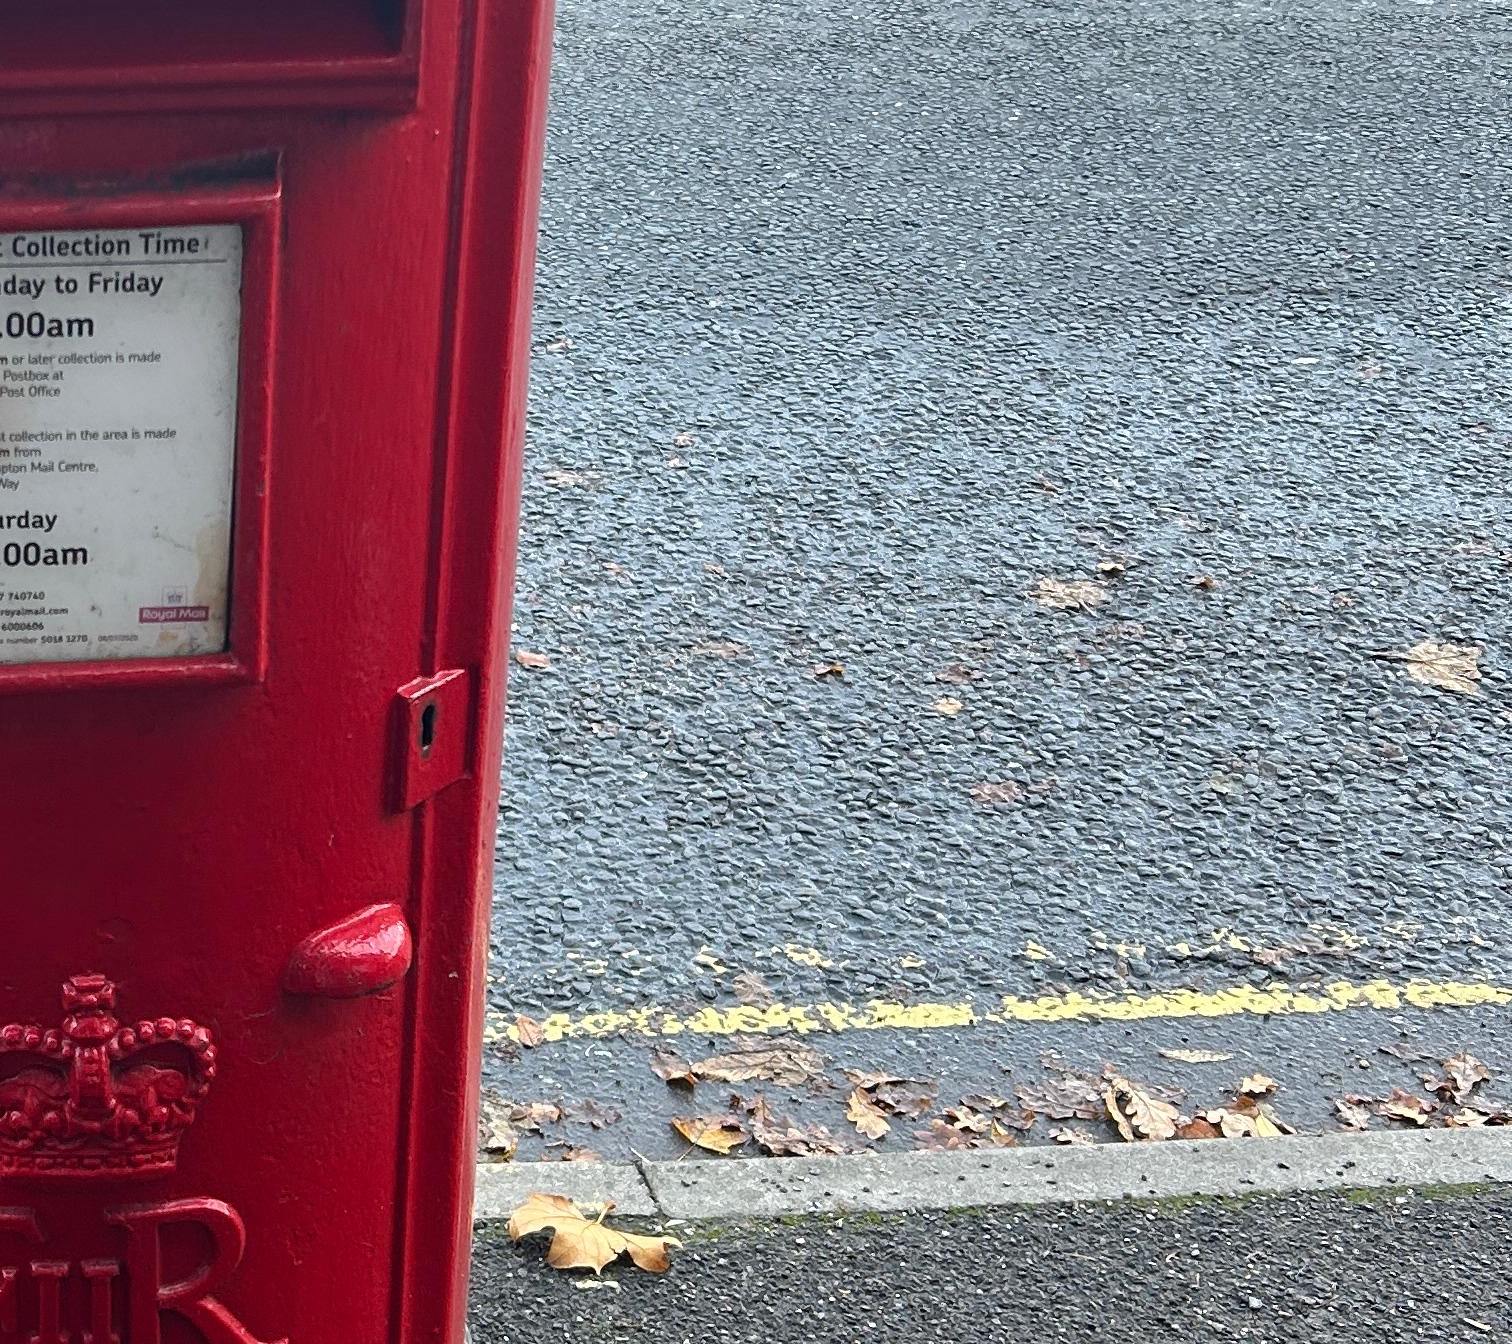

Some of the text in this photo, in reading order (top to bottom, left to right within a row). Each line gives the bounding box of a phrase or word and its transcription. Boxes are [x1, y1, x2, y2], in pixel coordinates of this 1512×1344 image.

[12, 235, 130, 257] Collection
[54, 275, 78, 294] to
[88, 272, 164, 296] Friday
[12, 356, 24, 365] or
[28, 354, 55, 365] later
[58, 353, 111, 364] collection
[115, 351, 124, 363] is
[128, 351, 161, 363] made
[3, 370, 49, 381] Postbox
[52, 370, 64, 381] at
[0, 386, 24, 397] Post
[28, 385, 61, 397] Office
[9, 430, 62, 442] collection
[66, 429, 77, 440] in
[80, 429, 99, 440] the
[103, 431, 128, 440] area
[131, 428, 140, 439] is
[144, 428, 177, 439] made
[14, 447, 41, 457] from
[30, 461, 55, 473] Mail
[143, 608, 206, 621] Royal Mail
